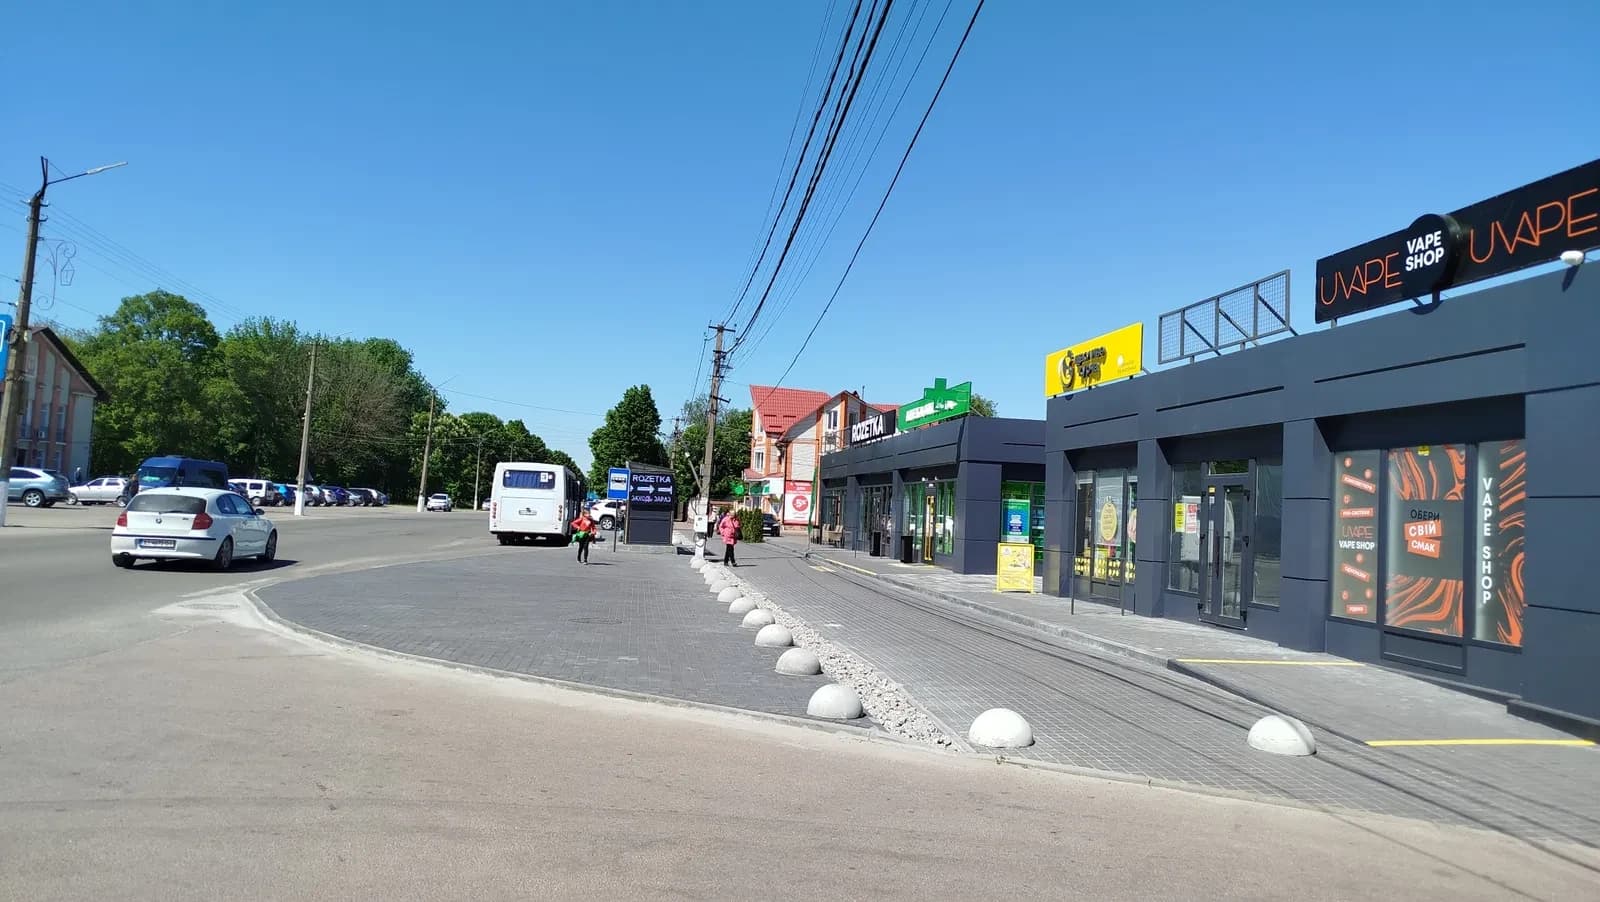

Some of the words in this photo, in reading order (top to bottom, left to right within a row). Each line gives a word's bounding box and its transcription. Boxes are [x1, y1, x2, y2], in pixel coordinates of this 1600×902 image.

[1470, 187, 1599, 264] UVAPE
[1406, 230, 1442, 254] VAPE
[1405, 248, 1444, 271] SHOP
[1320, 251, 1403, 305] UVAPE
[851, 414, 884, 443] ROZETKA
[632, 474, 671, 483] ROZETKA
[1410, 509, 1440, 521] ОБЕРИ
[1481, 477, 1493, 536] VAPE
[1408, 520, 1436, 537] СВІЙ
[1338, 540, 1355, 550] VAPE
[1356, 541, 1375, 551] SHOP
[1411, 540, 1436, 552] СМАК
[1481, 546, 1493, 604] SHOP
